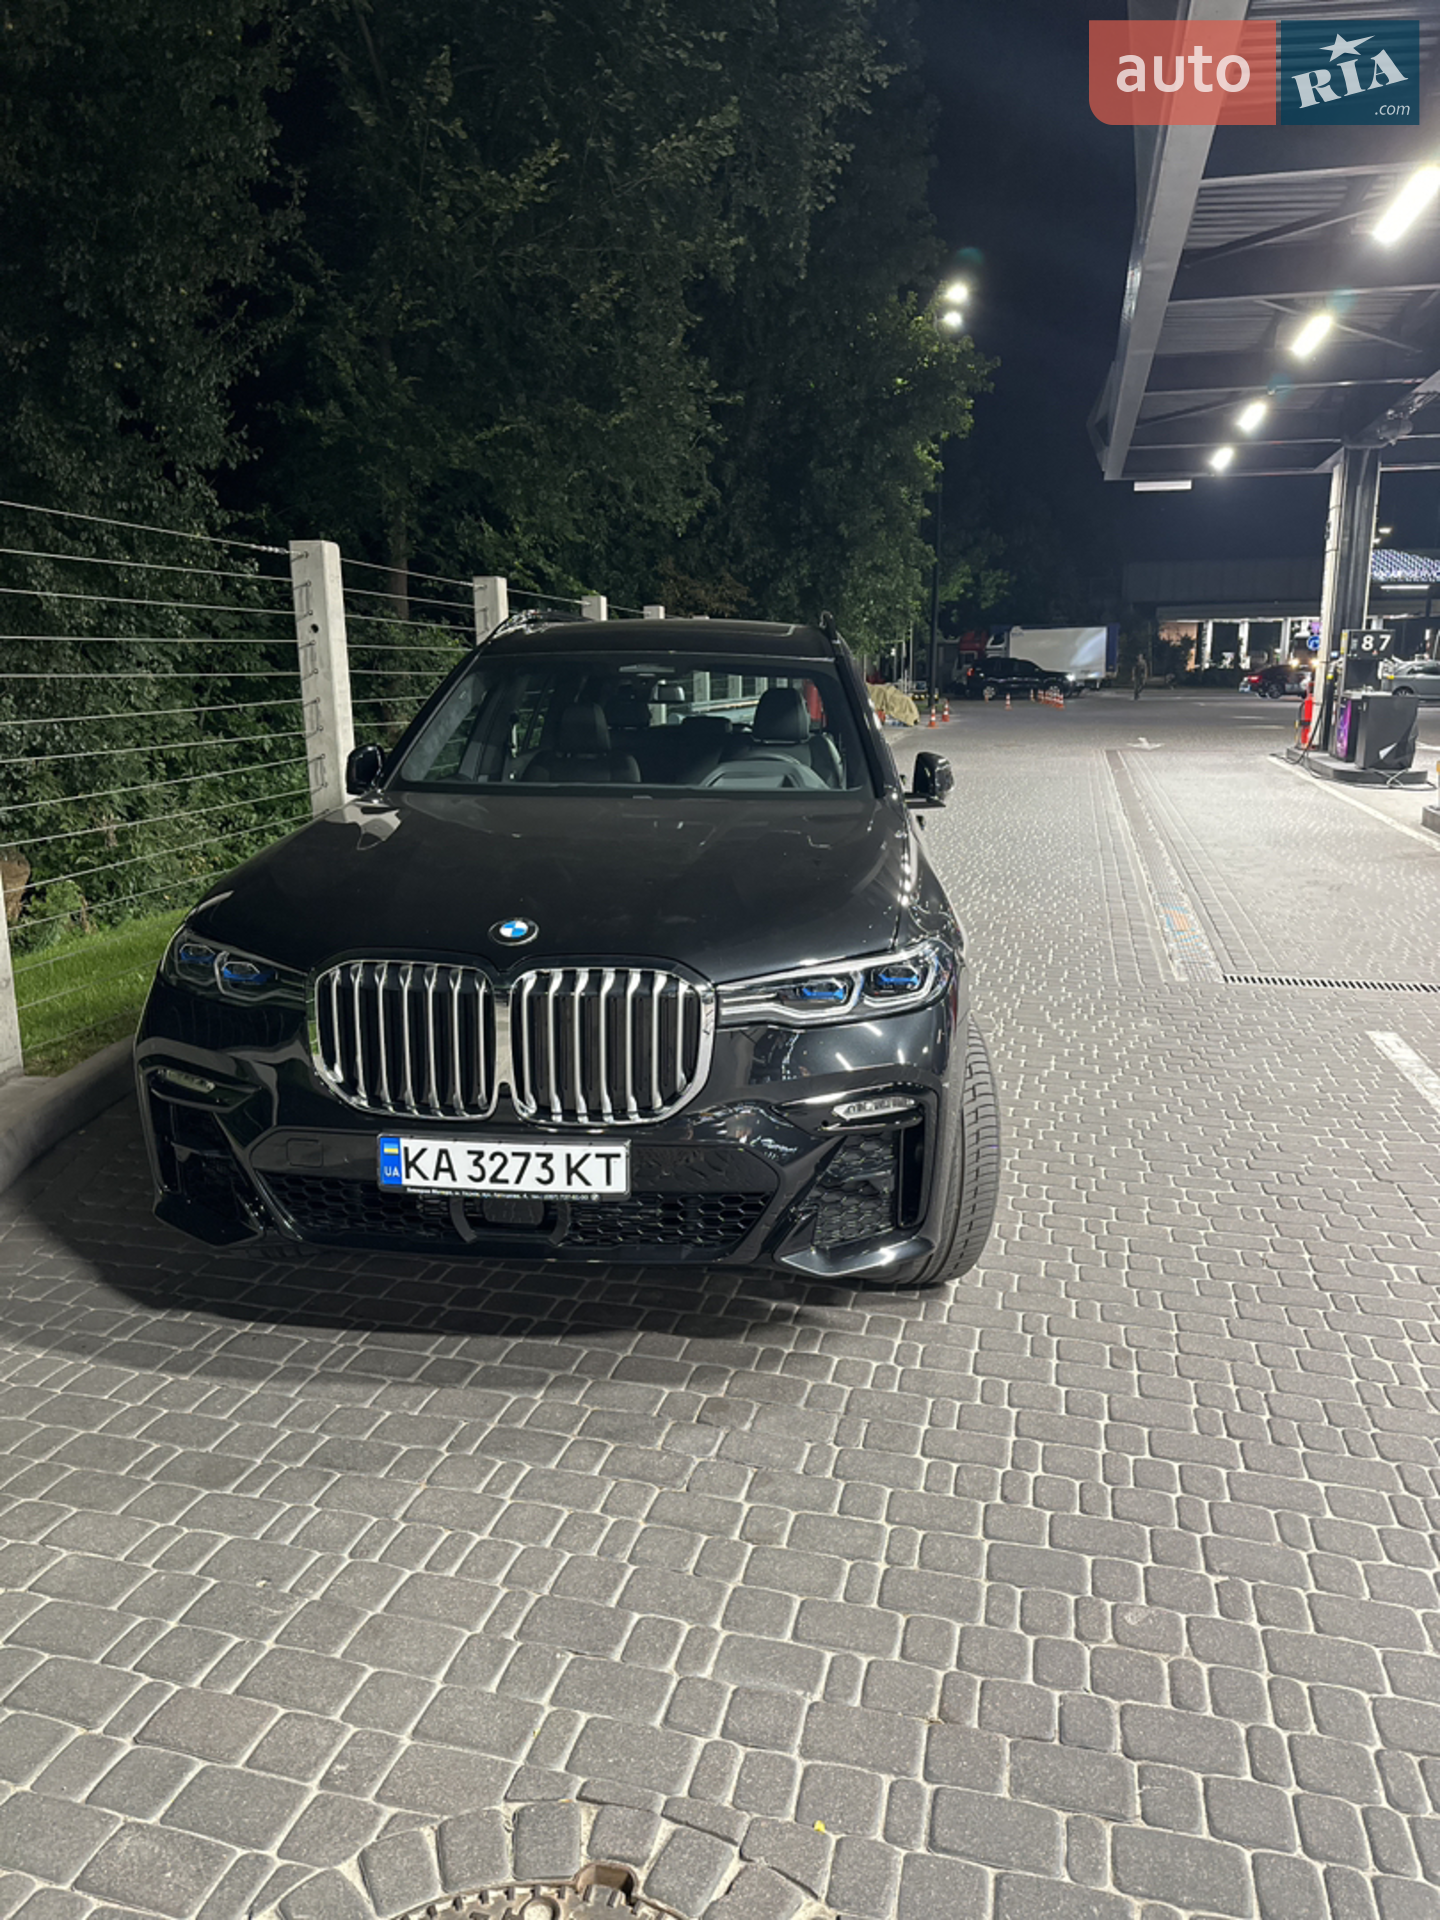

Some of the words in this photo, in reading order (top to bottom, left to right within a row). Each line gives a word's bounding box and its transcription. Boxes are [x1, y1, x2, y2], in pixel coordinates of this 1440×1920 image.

[383, 1166, 400, 1178] UA
[403, 1146, 457, 1182] KA
[467, 1150, 555, 1185] 3273
[566, 1153, 621, 1186] KT
